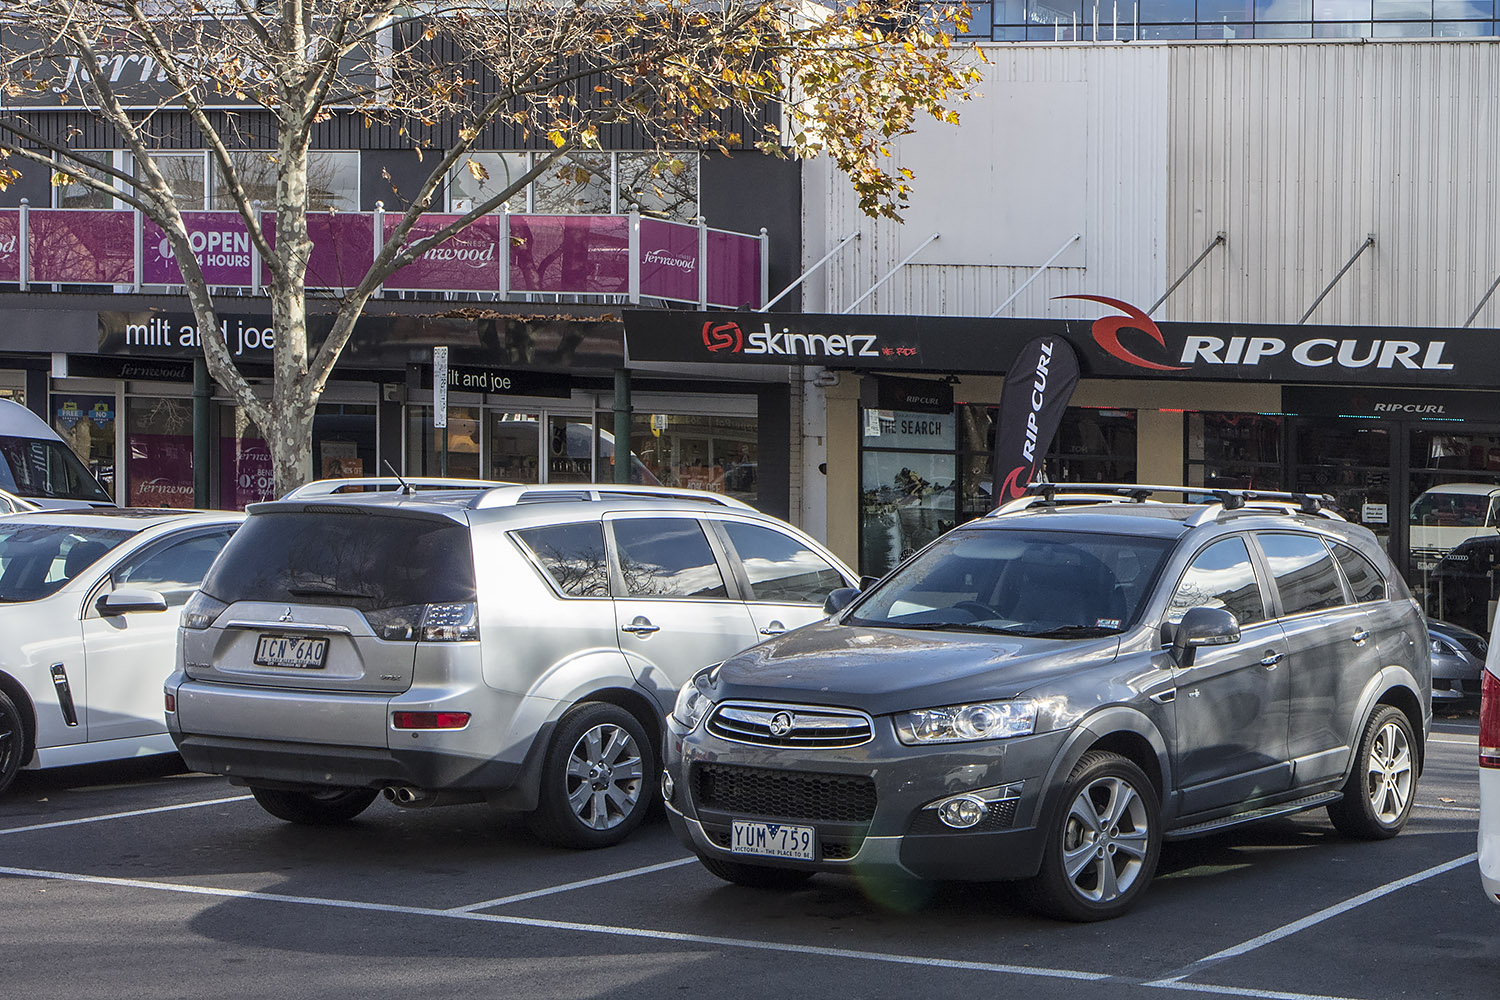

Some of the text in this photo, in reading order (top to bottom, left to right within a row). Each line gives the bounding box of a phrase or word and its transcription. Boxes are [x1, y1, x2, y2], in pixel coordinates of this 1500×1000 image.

[191, 231, 250, 253] OPEN
[207, 255, 250, 267] HOURS
[642, 250, 696, 270] fernwood
[126, 319, 171, 346] milt
[235, 320, 275, 356] joe
[744, 323, 879, 357] skinnerz
[1180, 335, 1455, 370] RIP CURL
[118, 363, 188, 378] fernwood
[447, 370, 511, 392] ilt and joe
[1022, 341, 1054, 463] RIP CURL
[1373, 402, 1446, 414] RIP CURL
[901, 422, 941, 435] SEARCH
[136, 480, 194, 495] fernwoo
[261, 640, 288, 658] 1CN
[734, 825, 810, 851] YUM 759
